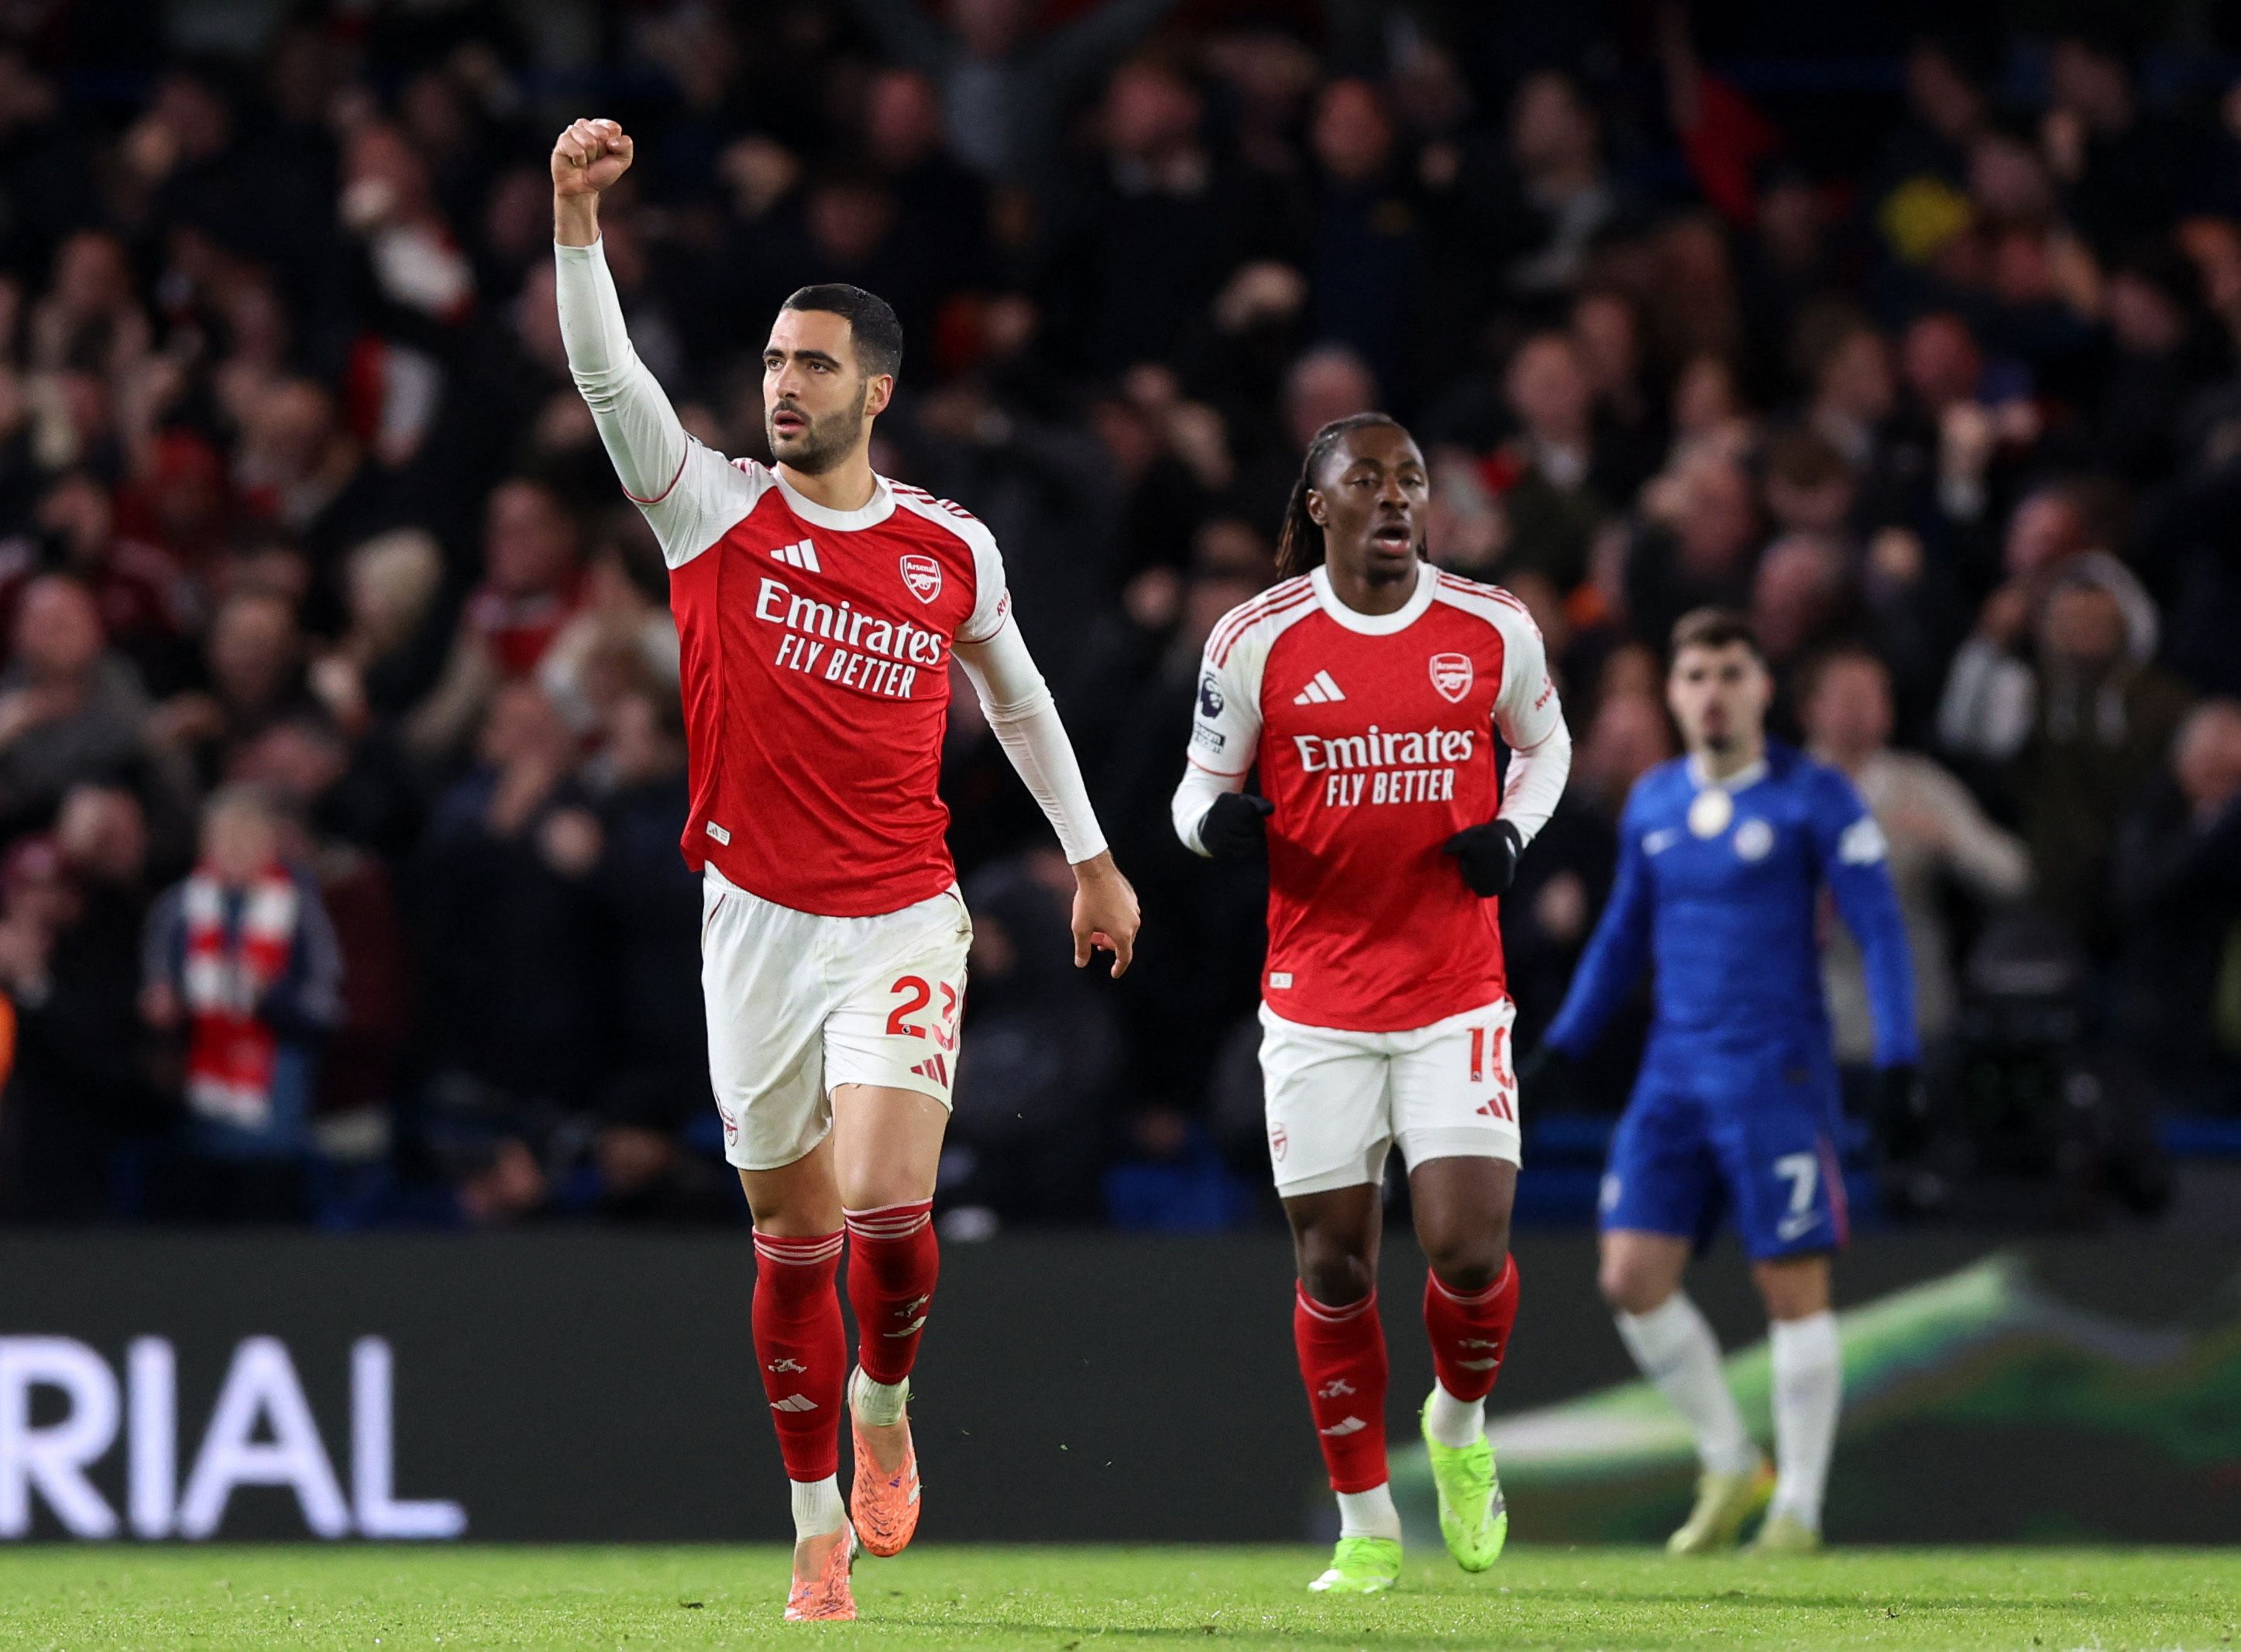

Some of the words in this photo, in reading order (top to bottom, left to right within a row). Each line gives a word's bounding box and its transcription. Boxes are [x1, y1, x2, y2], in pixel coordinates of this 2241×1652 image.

[906, 562, 935, 573] Arsenal
[755, 578, 942, 665] Emirates
[775, 634, 826, 674] FLY
[826, 650, 916, 697] BETTER
[1294, 725, 1473, 771] Emirates
[1326, 774, 1366, 807] FLY
[1372, 769, 1454, 804] BETTER
[885, 975, 957, 1052] 23
[1773, 1153, 1817, 1214] 7
[0, 1334, 466, 1539] RIAL
